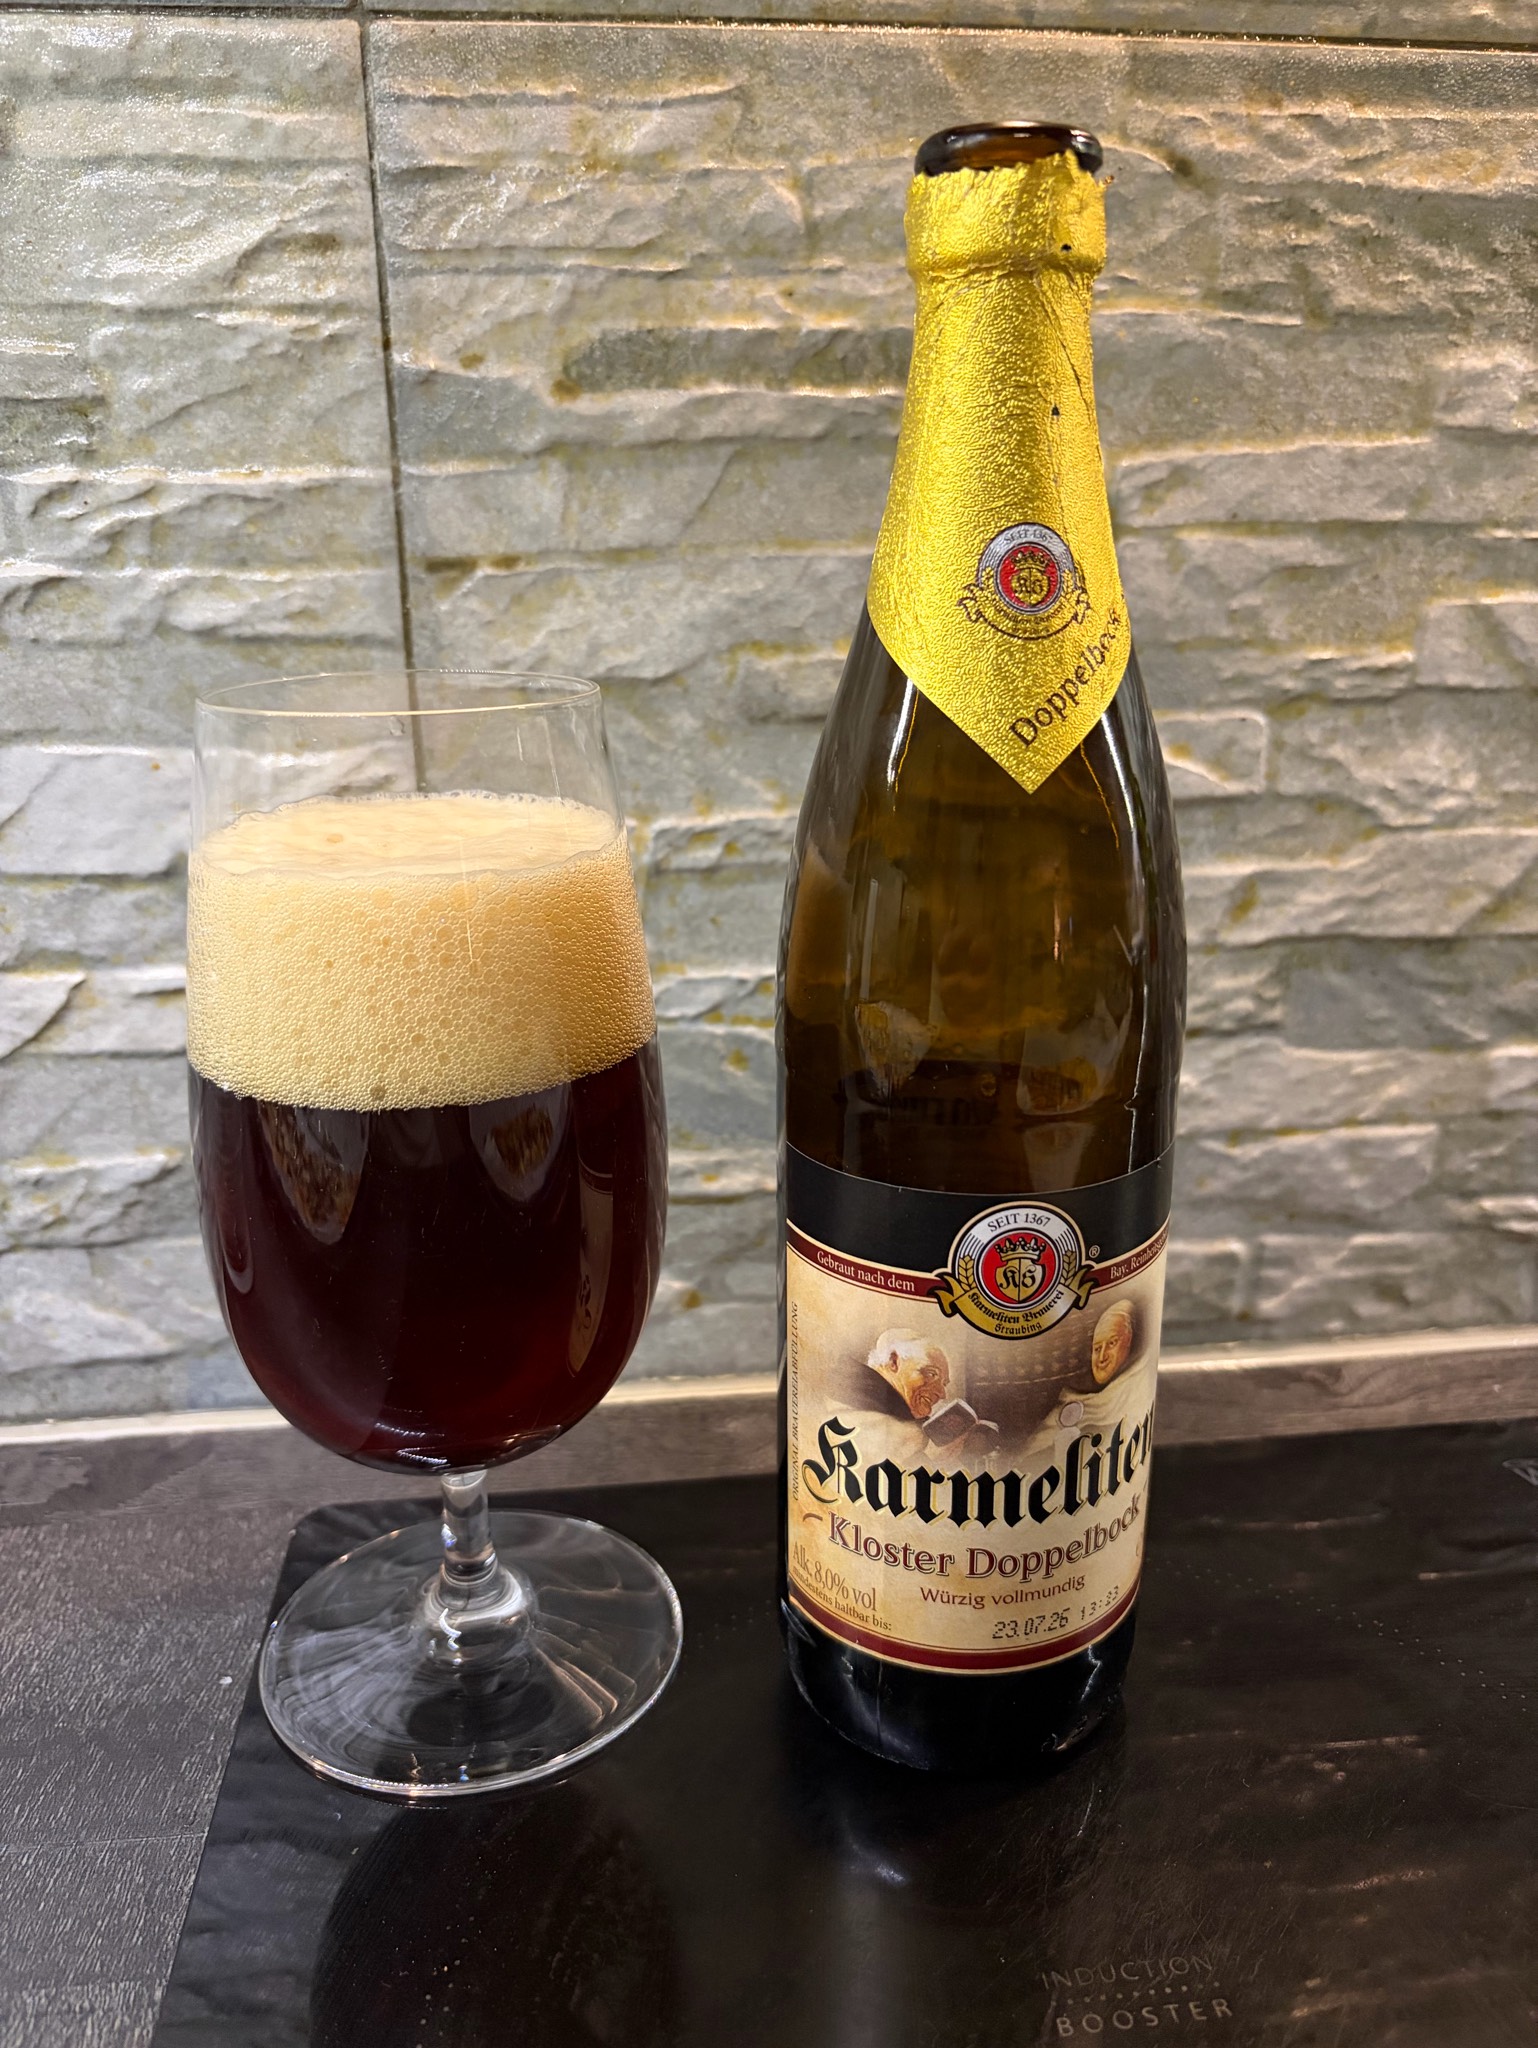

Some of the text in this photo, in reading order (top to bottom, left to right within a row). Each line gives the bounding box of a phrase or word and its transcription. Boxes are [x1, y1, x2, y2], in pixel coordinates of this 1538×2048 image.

[987, 1212, 1051, 1233] SEIT 1367
[816, 1250, 915, 1292] Gebraut nach dem
[1110, 1266, 1129, 1279] Bay.
[967, 1289, 1065, 1324] Karmeliten Brauerei
[994, 1322, 1043, 1335] Straubing
[790, 1443, 799, 1501] ORIGINAL
[801, 1400, 1154, 1530] Karmeliten
[827, 1493, 1142, 1584] Kloster Doppelbock
[814, 1560, 849, 1600] 8,0%
[851, 1587, 877, 1612] vol
[919, 1574, 1086, 1610] Würzig vollmundig
[834, 1596, 871, 1623] haltbar
[872, 1613, 893, 1632] bis:
[991, 1606, 1071, 1640] 23.07.26
[1041, 1954, 1214, 1990] INDUCTION
[1055, 1997, 1233, 2038] BOOSTER
